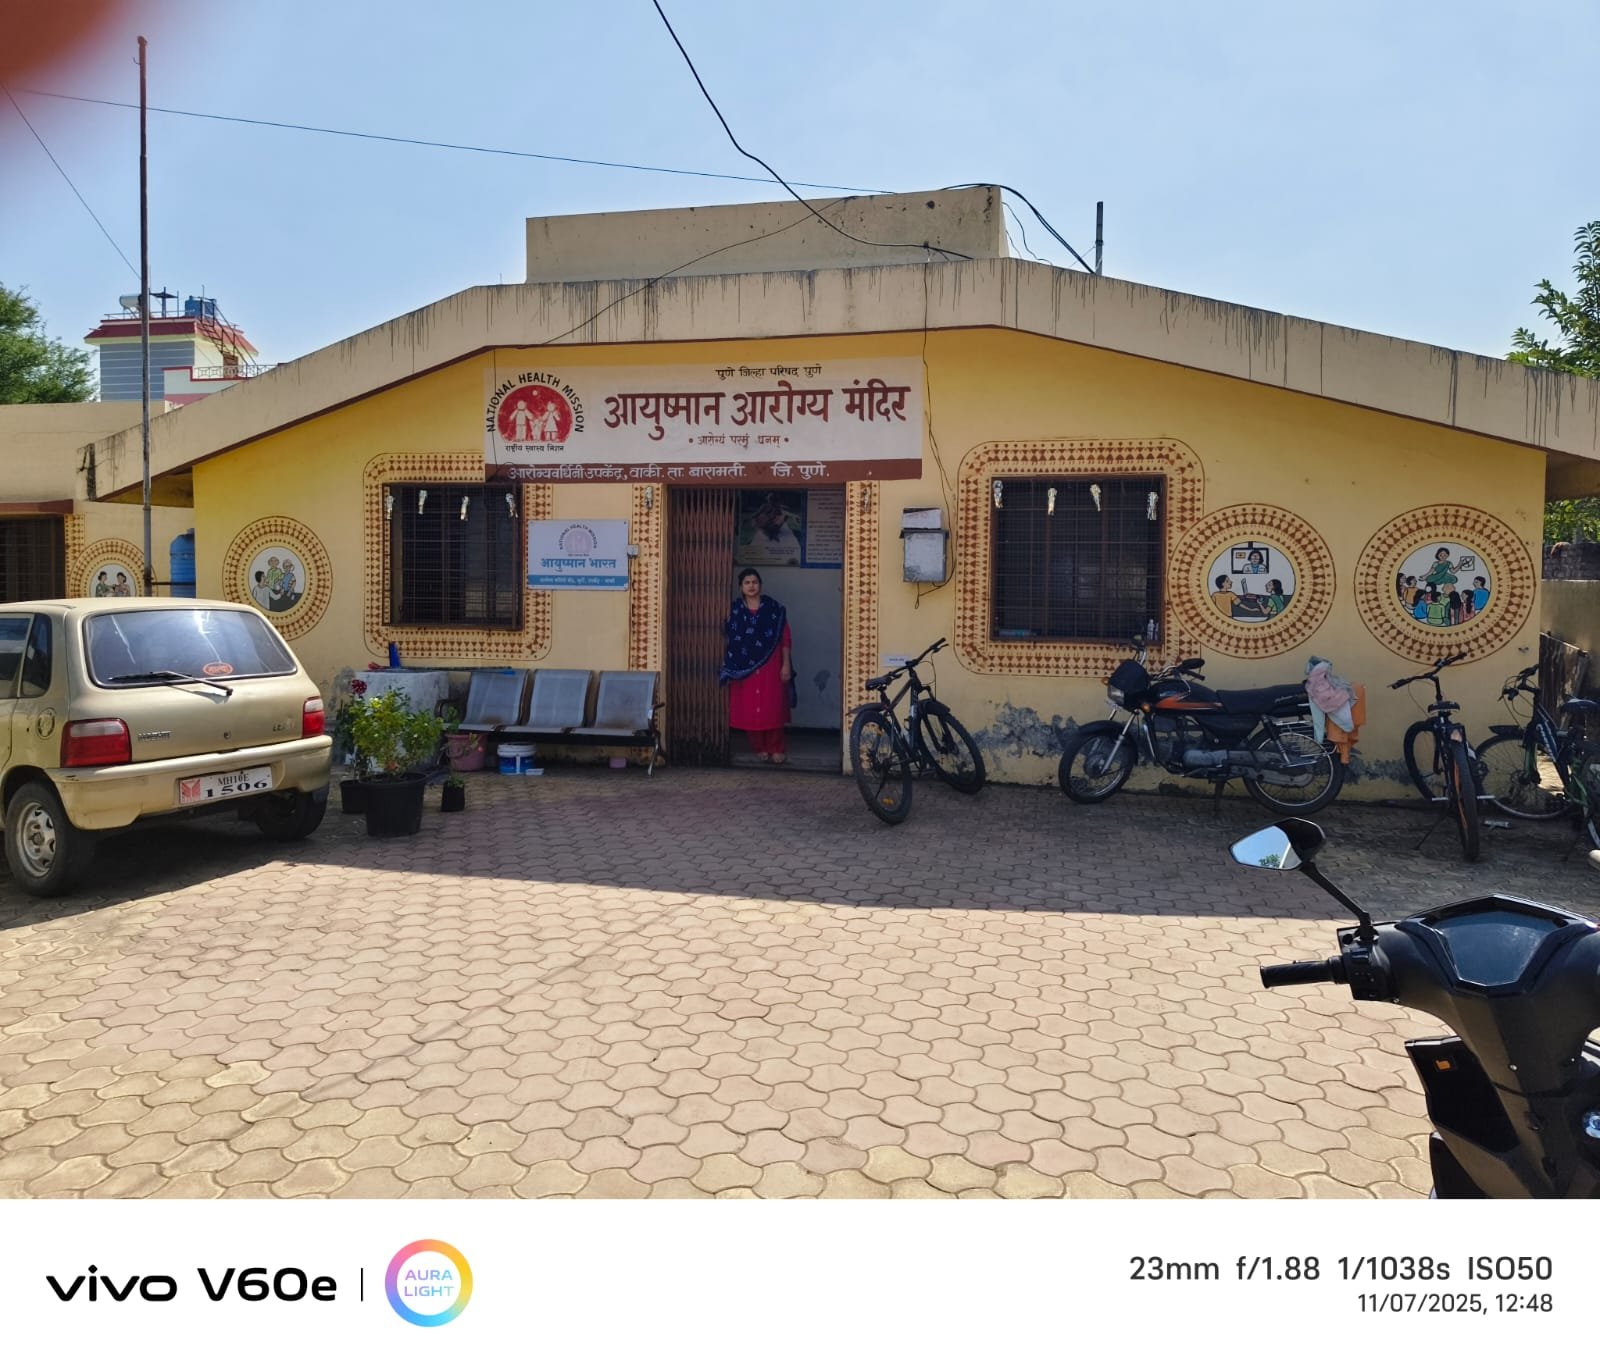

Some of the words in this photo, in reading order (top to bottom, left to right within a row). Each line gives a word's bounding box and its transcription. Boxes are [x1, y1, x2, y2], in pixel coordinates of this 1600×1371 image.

[715, 366, 735, 380] पुणे
[738, 365, 767, 379] जिल्हा
[803, 363, 823, 378] पुणे
[486, 380, 516, 433] NATIONAL
[518, 372, 561, 388] HEALTH
[562, 384, 585, 433] MISSION
[603, 391, 726, 441] आयुष्मान
[730, 379, 834, 426] आरोग्य
[841, 378, 912, 422] मंदिर
[205, 779, 268, 798] 1506
